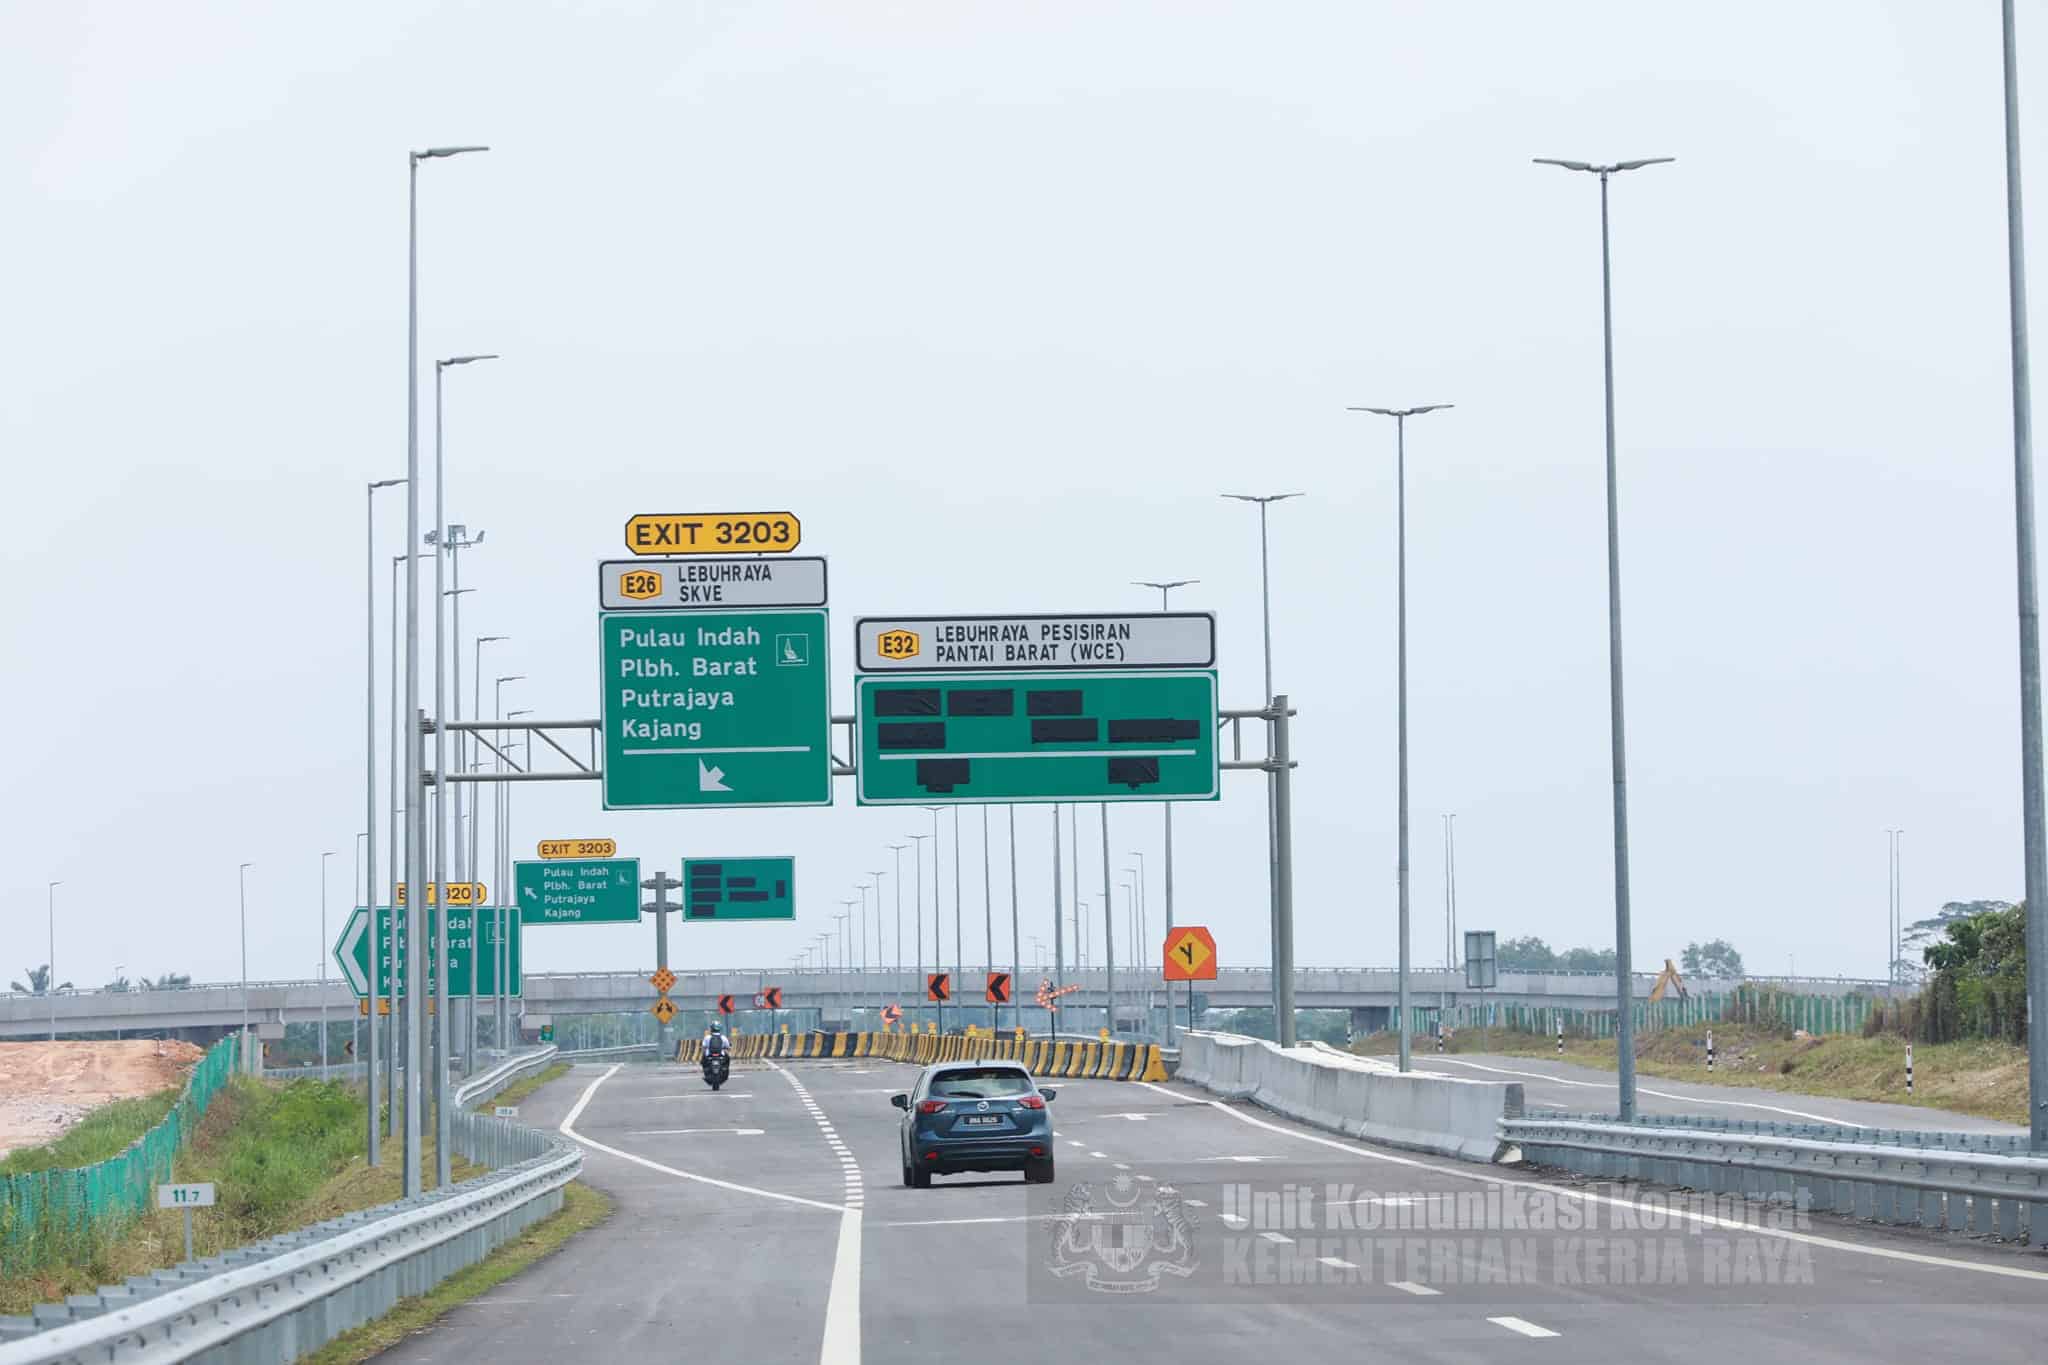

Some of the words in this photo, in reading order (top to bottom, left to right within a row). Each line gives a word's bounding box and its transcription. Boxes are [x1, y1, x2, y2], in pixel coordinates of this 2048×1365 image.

[636, 523, 703, 546] EXIT
[715, 521, 790, 544] 3203
[678, 564, 773, 583] LEBUHRAYA
[625, 575, 657, 595] E26
[679, 585, 723, 602] SKVE
[620, 628, 685, 648] Pulau
[697, 626, 761, 646] Indah
[936, 624, 1029, 643] LEBUHRAYA
[1041, 623, 1131, 642] PESISIRAN
[883, 635, 914, 655] E32
[936, 643, 994, 663] PANTAI
[1005, 643, 1059, 661] BARAT
[1070, 642, 1126, 662] (WCE)
[621, 658, 680, 678] Plbh.
[692, 656, 758, 676] Barat
[621, 687, 735, 711] Putrajaya
[622, 719, 702, 741] Kajang
[541, 843, 571, 855] EXIT
[577, 842, 612, 854] 3203
[543, 867, 574, 877] Pulau
[580, 867, 609, 877] Indah
[578, 881, 608, 890] Barat
[544, 895, 596, 905] Putrajaya
[544, 908, 581, 918] Kajang
[173, 1189, 200, 1202] 11.7
